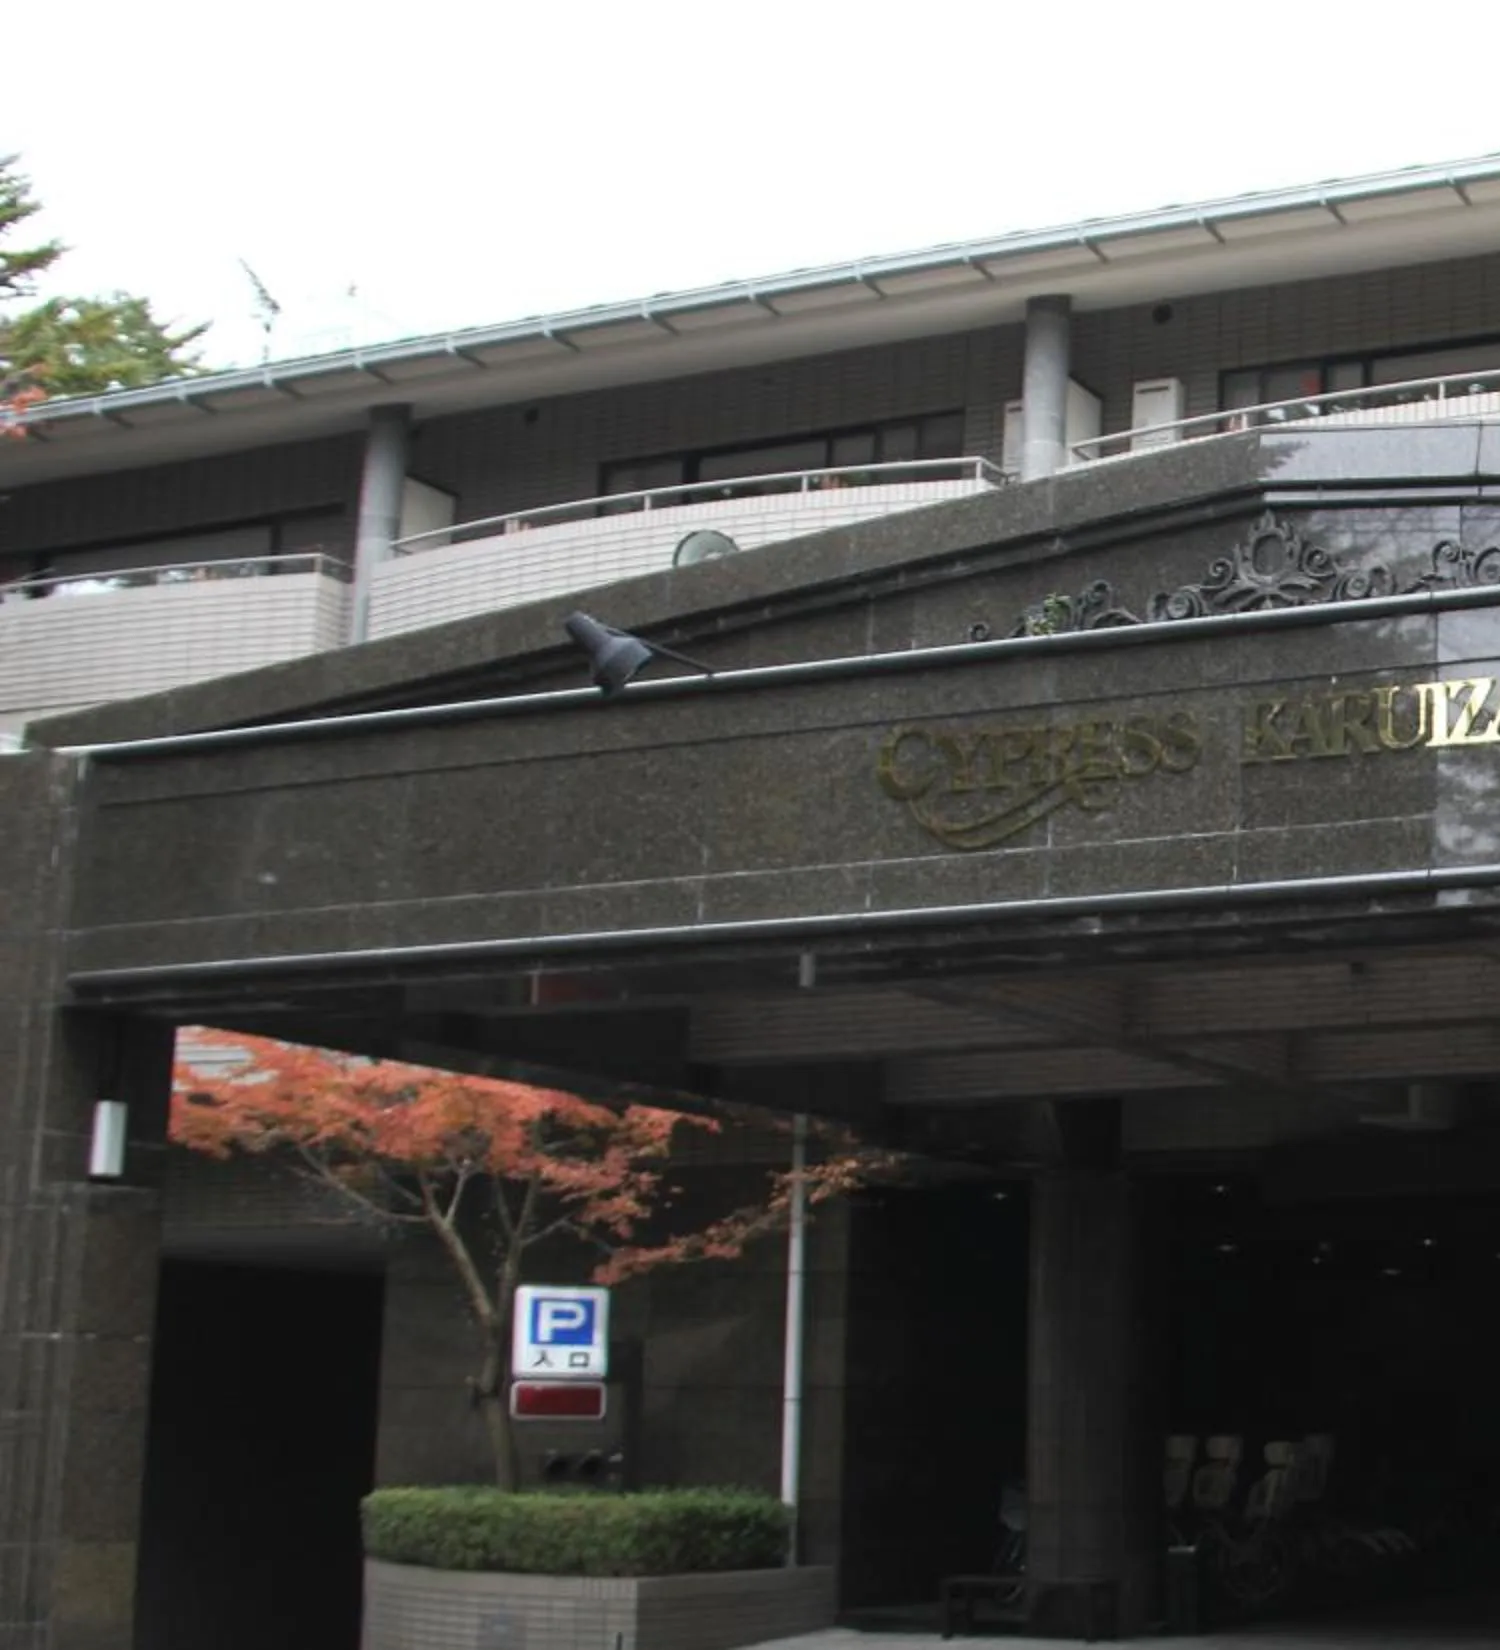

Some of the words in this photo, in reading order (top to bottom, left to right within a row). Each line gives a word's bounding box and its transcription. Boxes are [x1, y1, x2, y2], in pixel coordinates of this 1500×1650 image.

[878, 712, 1201, 848] CYPRESS
[538, 1301, 587, 1342] P
[533, 1350, 590, 1367] 入口
